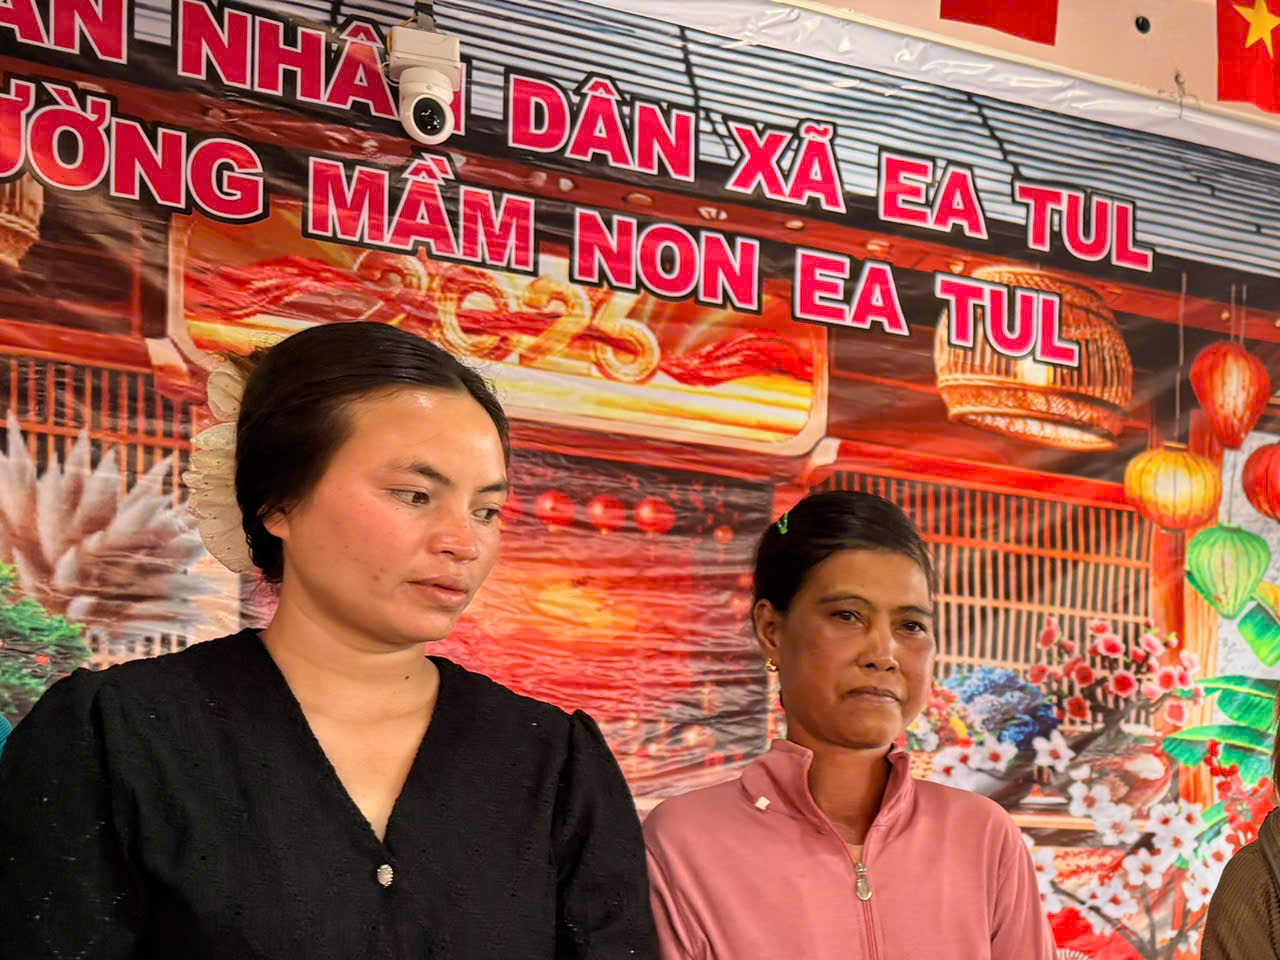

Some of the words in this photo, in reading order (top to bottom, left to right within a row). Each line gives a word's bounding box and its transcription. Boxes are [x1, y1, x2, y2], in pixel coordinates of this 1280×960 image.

[178, 0, 468, 135] NHÂ
[508, 77, 696, 182] DÂN
[725, 124, 848, 214] XÃ
[879, 151, 988, 240] EA
[1015, 183, 1155, 273] TUL
[306, 151, 536, 273] MẦM
[573, 208, 761, 311] NON
[794, 246, 909, 336] EA
[935, 271, 1080, 368] TUL
